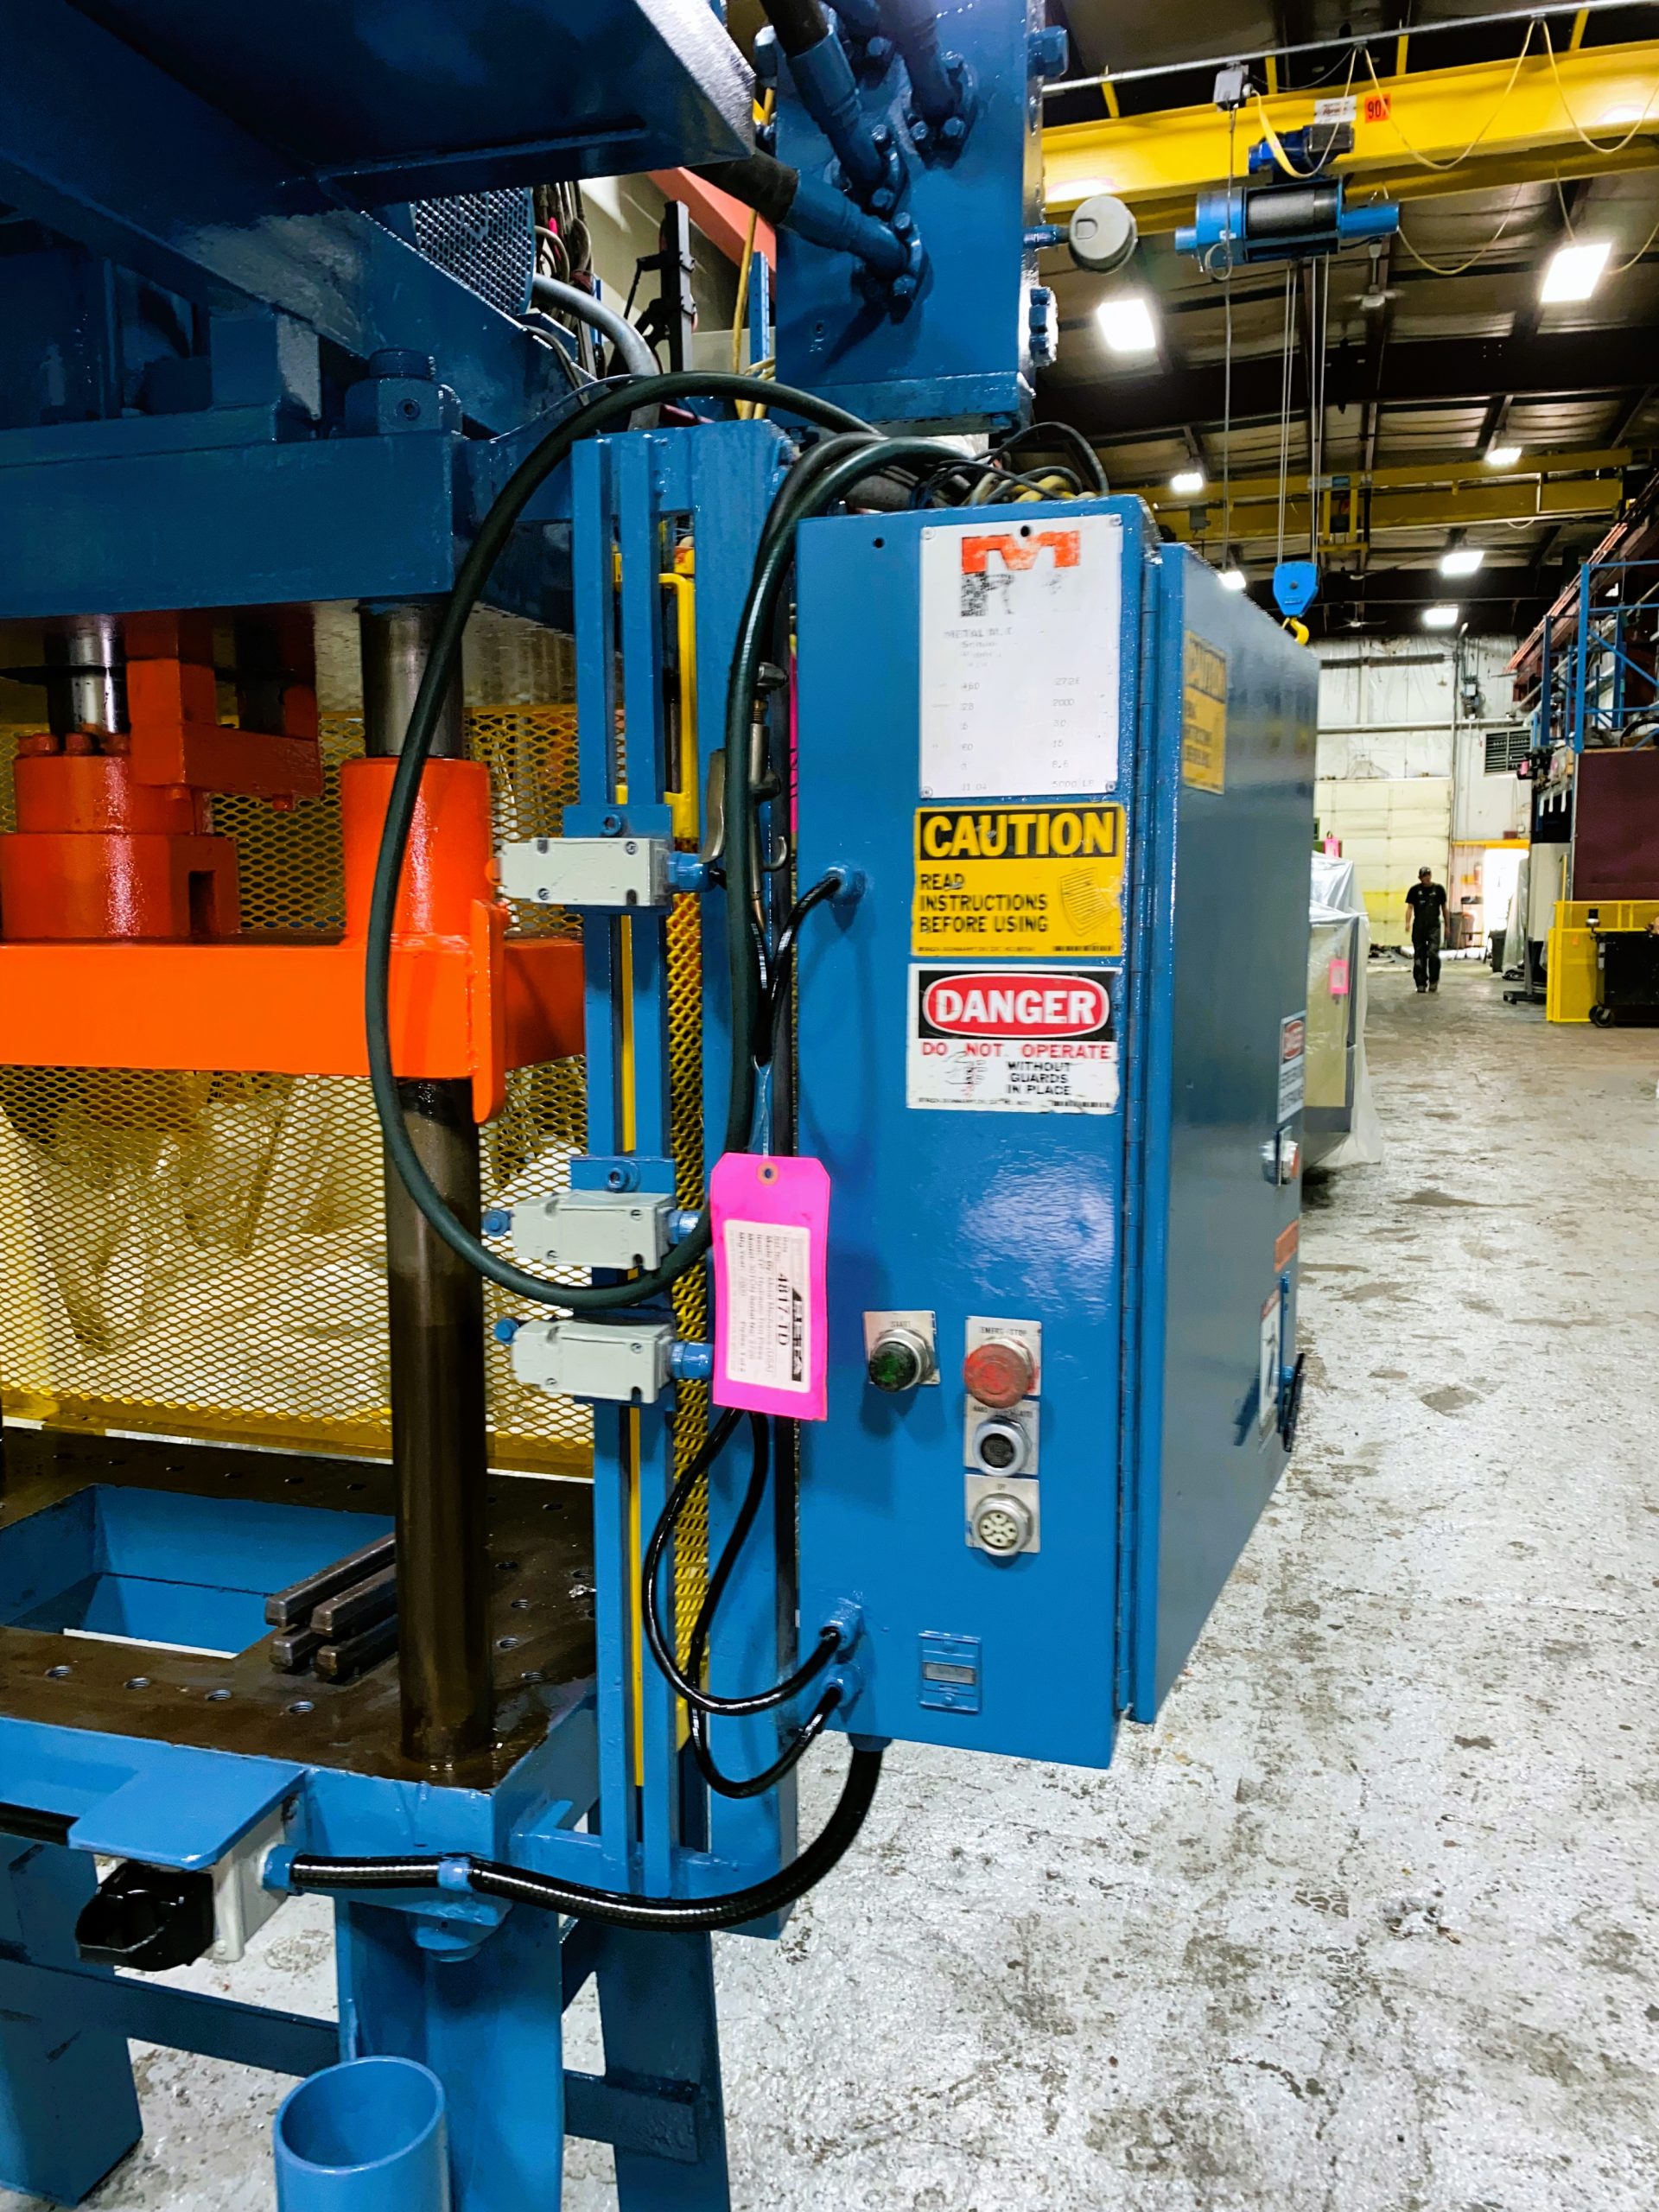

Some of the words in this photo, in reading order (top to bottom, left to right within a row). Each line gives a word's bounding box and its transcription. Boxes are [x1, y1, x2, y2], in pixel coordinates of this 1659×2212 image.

[922, 810, 1116, 858] CAUTION
[920, 873, 965, 891] READ
[920, 893, 1048, 912] INSTRUCTIONS
[920, 915, 987, 933] BEFORE
[993, 915, 1048, 933] USING
[935, 988, 1097, 1026] DANGER
[921, 1041, 949, 1056] DO
[966, 1042, 1004, 1058] NOT
[1021, 1043, 1112, 1060] OPERATE
[1007, 1061, 1071, 1073] WITHOUT
[1010, 1071, 1068, 1084] GUARDS
[1007, 1084, 1020, 1095] IN
[1026, 1084, 1071, 1096] PLACE
